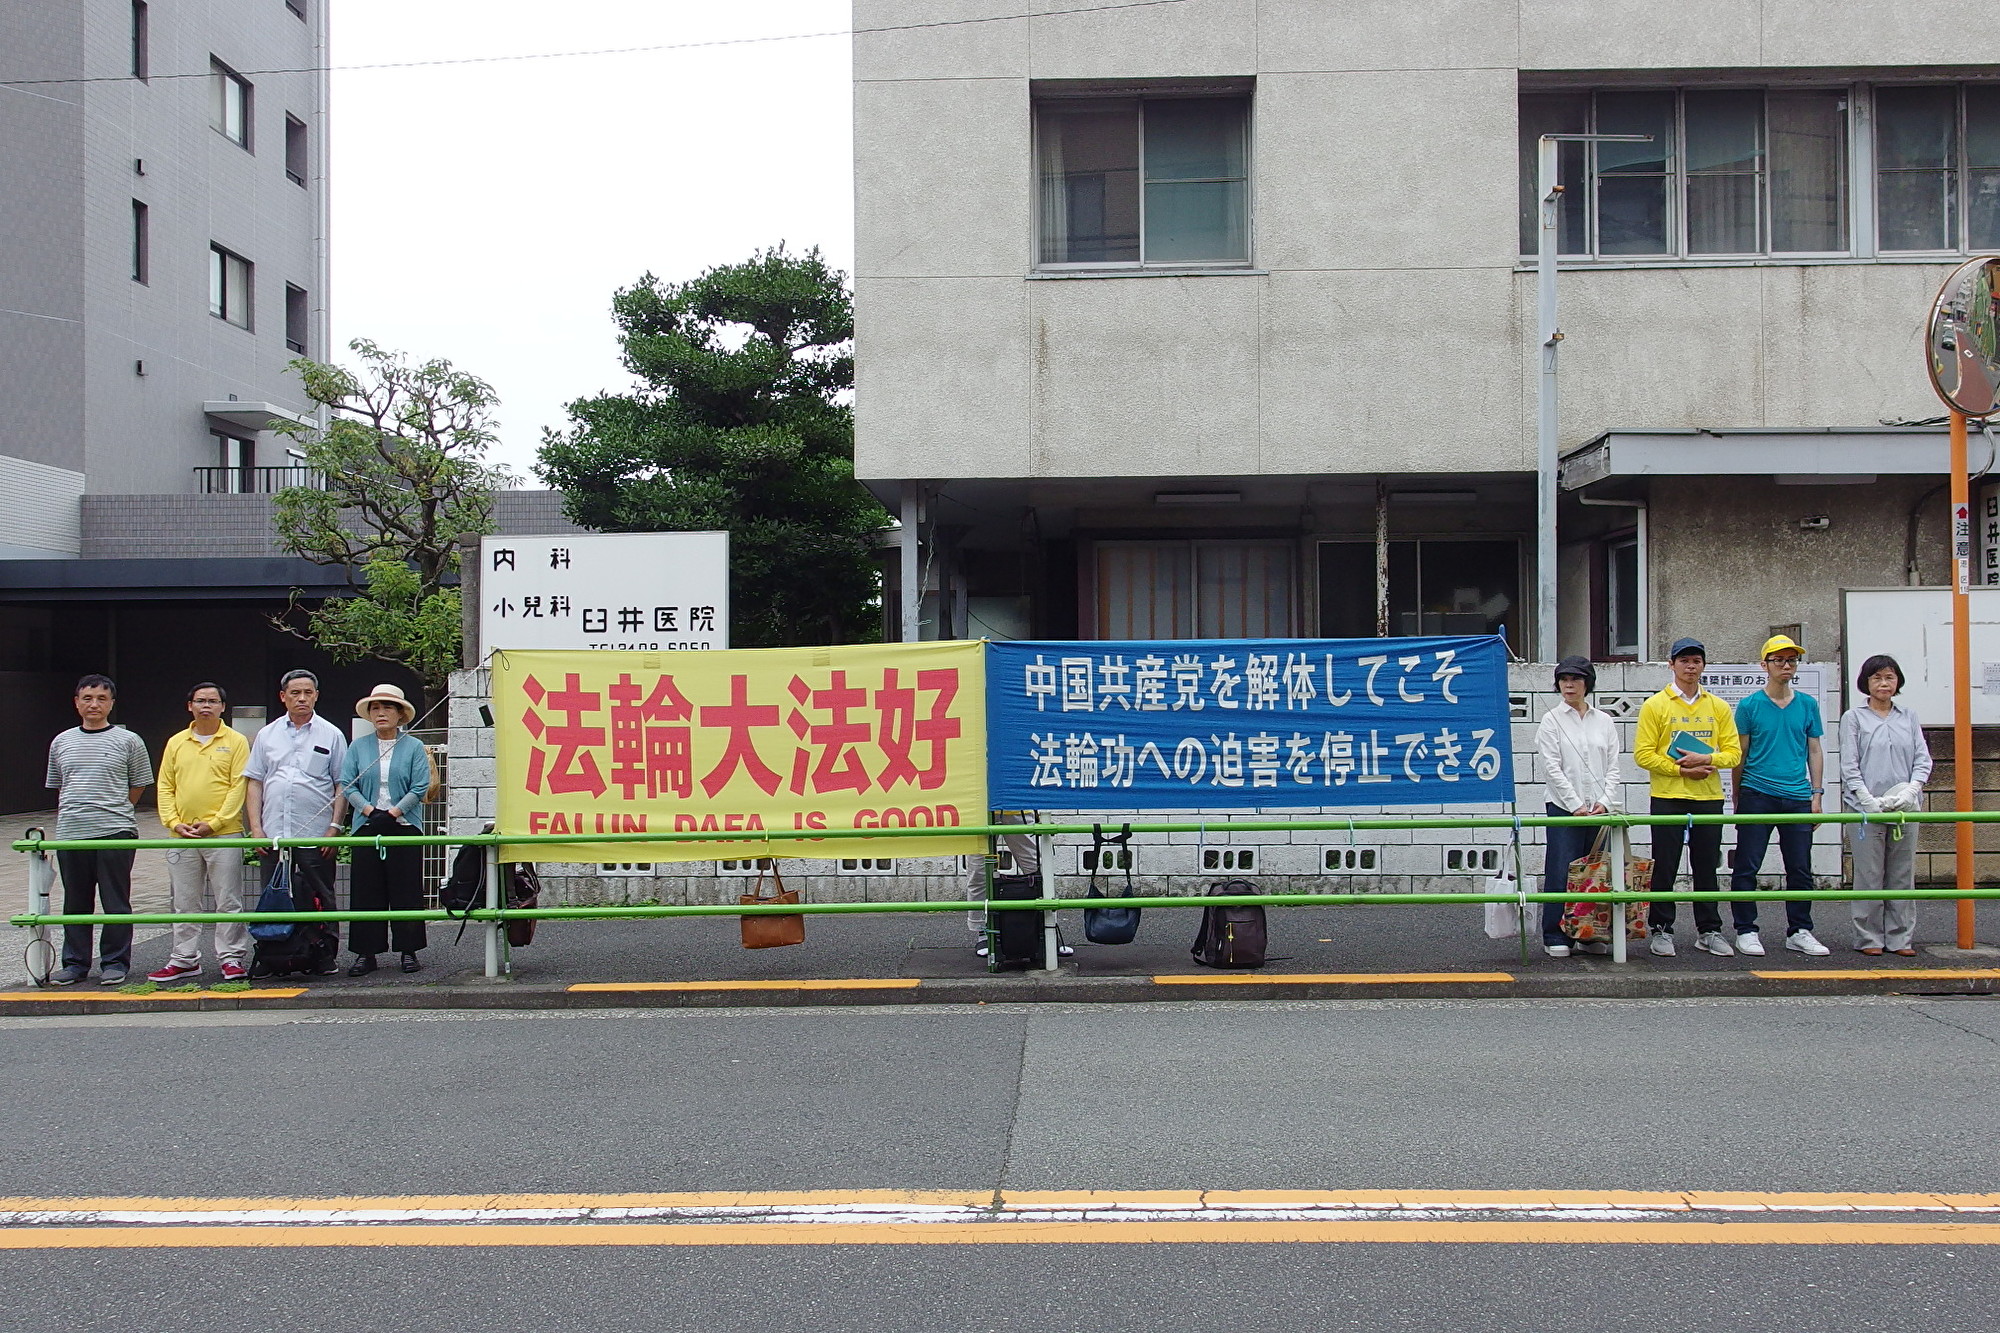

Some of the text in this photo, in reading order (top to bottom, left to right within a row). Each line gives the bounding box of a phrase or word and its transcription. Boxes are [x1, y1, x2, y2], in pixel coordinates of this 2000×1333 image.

[1956, 521, 1969, 556] 注意
[493, 548, 571, 572] 内科
[582, 605, 715, 634] 臼井医院
[1025, 649, 1464, 712] 中国共産党を解体してこそ
[521, 667, 962, 800] 法輪大法好
[1030, 727, 1502, 789] 法輪功への迫害を停止できる
[529, 804, 960, 843] FALUN DAFA IS GOOD
